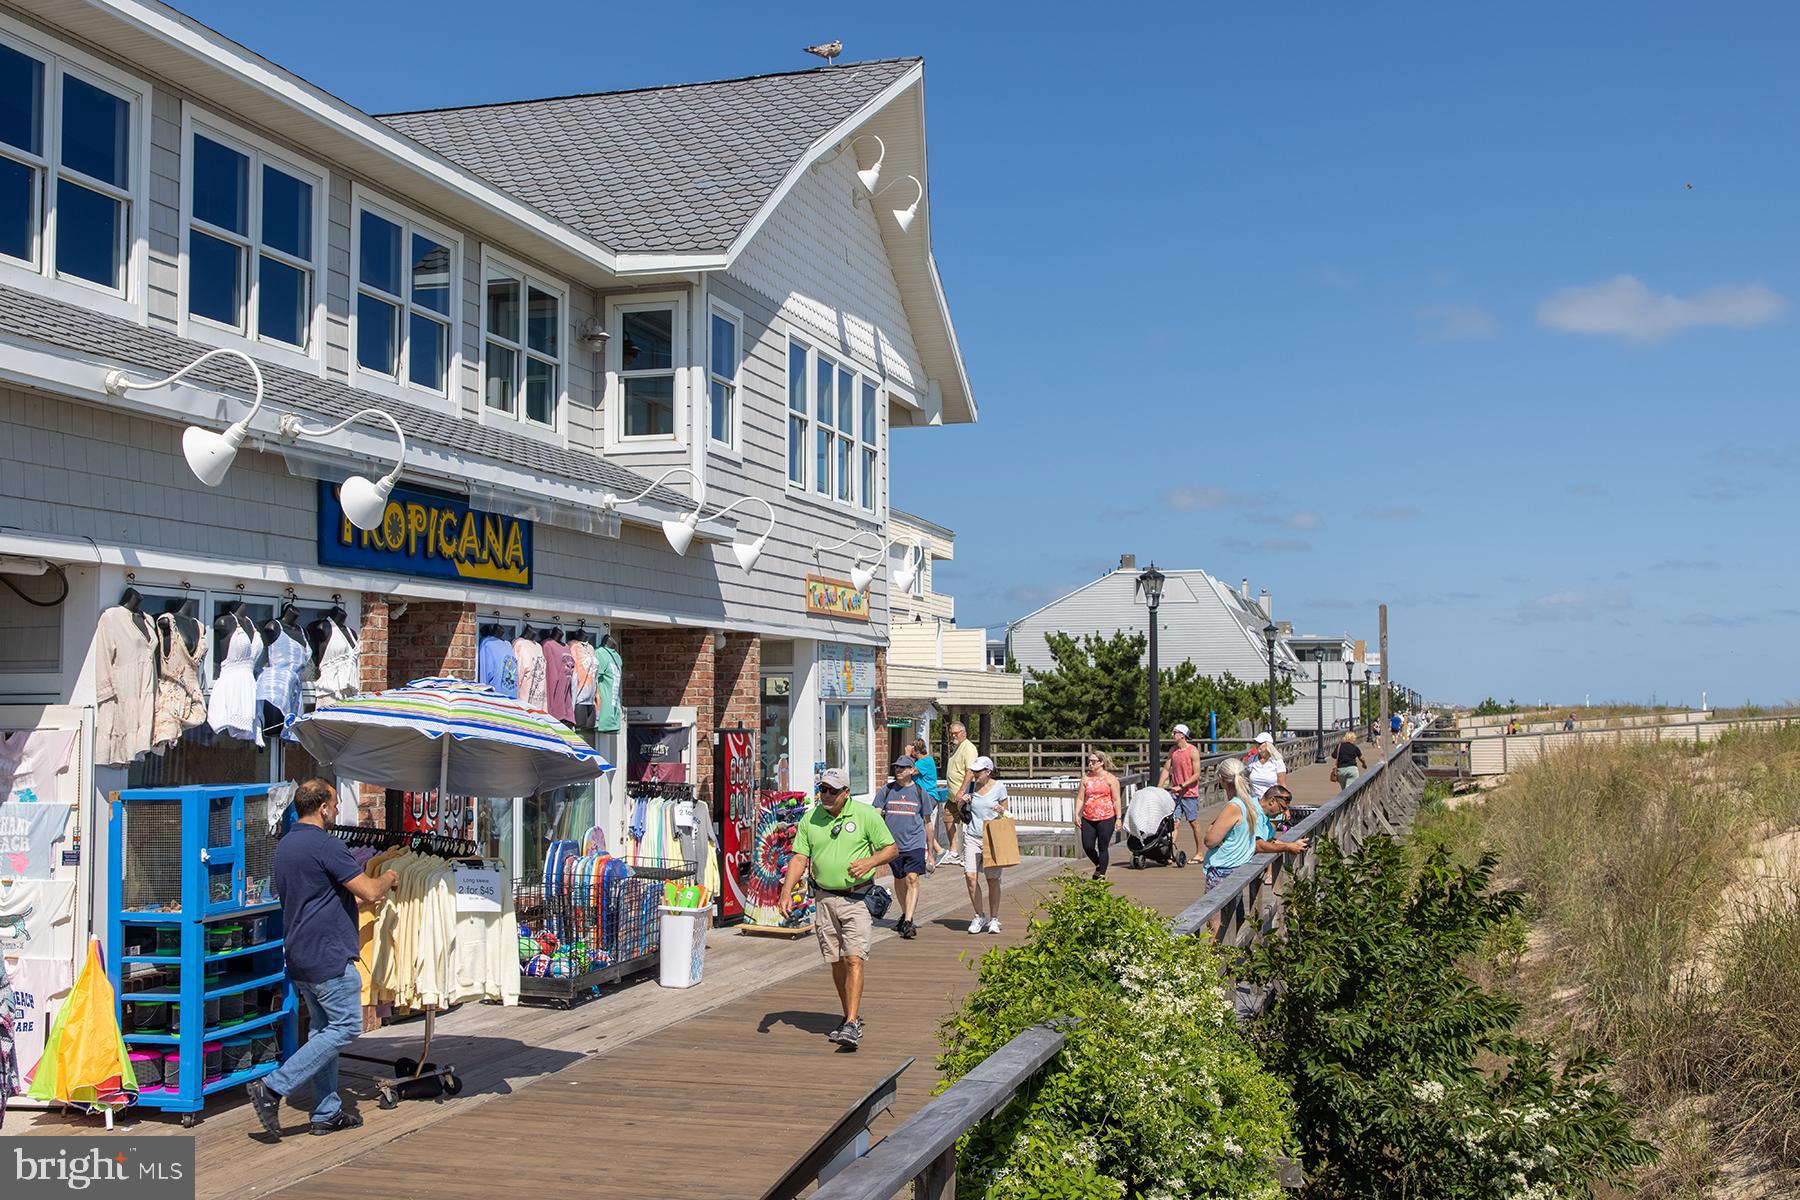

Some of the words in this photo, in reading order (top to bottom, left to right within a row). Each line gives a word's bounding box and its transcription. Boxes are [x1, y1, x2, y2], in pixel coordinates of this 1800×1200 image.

[0, 815, 31, 836] HANY
[0, 836, 30, 853] ACH
[458, 886, 464, 894] 2
[466, 886, 478, 895] for
[480, 886, 494, 896] $45
[13, 991, 34, 1009] EACH
[13, 1021, 34, 1032] ARE
